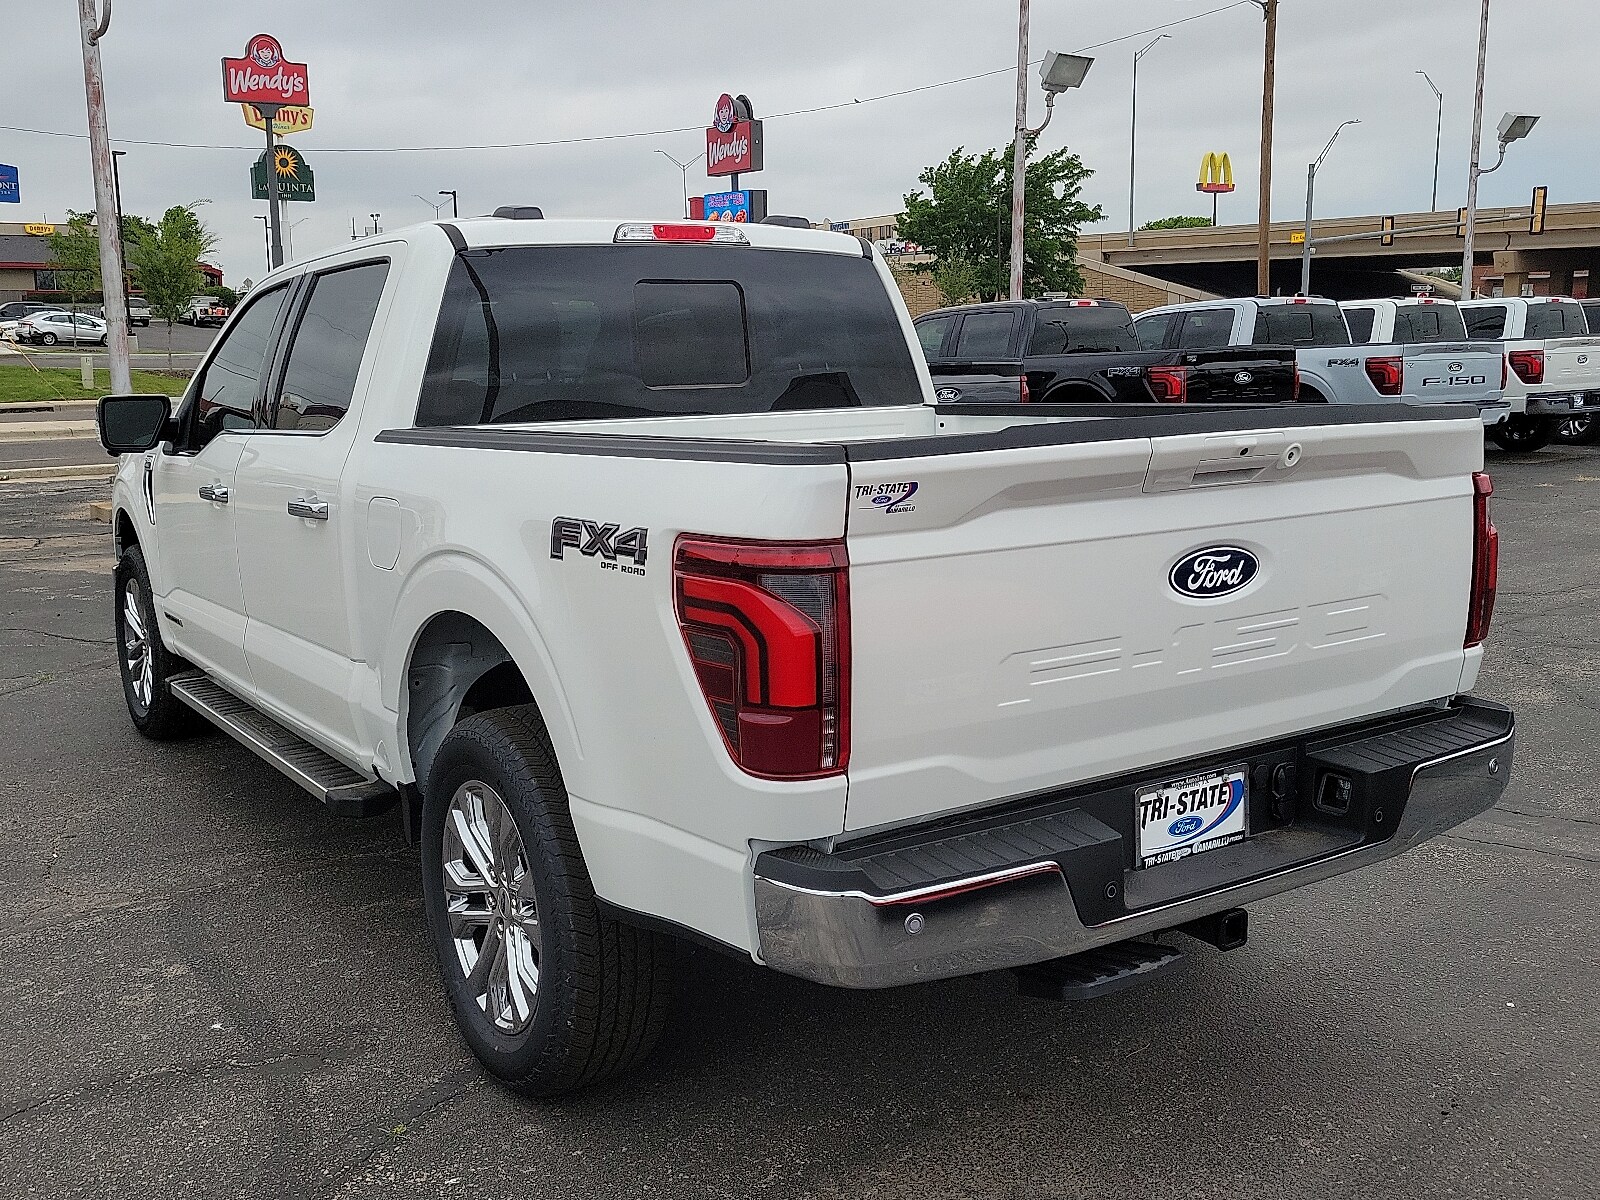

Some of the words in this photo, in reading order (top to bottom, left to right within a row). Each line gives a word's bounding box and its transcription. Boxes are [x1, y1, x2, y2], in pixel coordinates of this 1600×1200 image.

[229, 65, 304, 98] Wendy's
[708, 132, 748, 167] Wendy's
[267, 182, 314, 193] UINTA
[1327, 358, 1359, 367] FX4
[1108, 366, 1140, 377] FX4
[1421, 375, 1486, 387] F-150
[855, 482, 910, 499] TRI-STATE
[550, 516, 648, 567] FX4
[600, 562, 618, 571] OFF
[621, 565, 646, 576] ROAD
[1140, 783, 1230, 831] TRI-STATE
